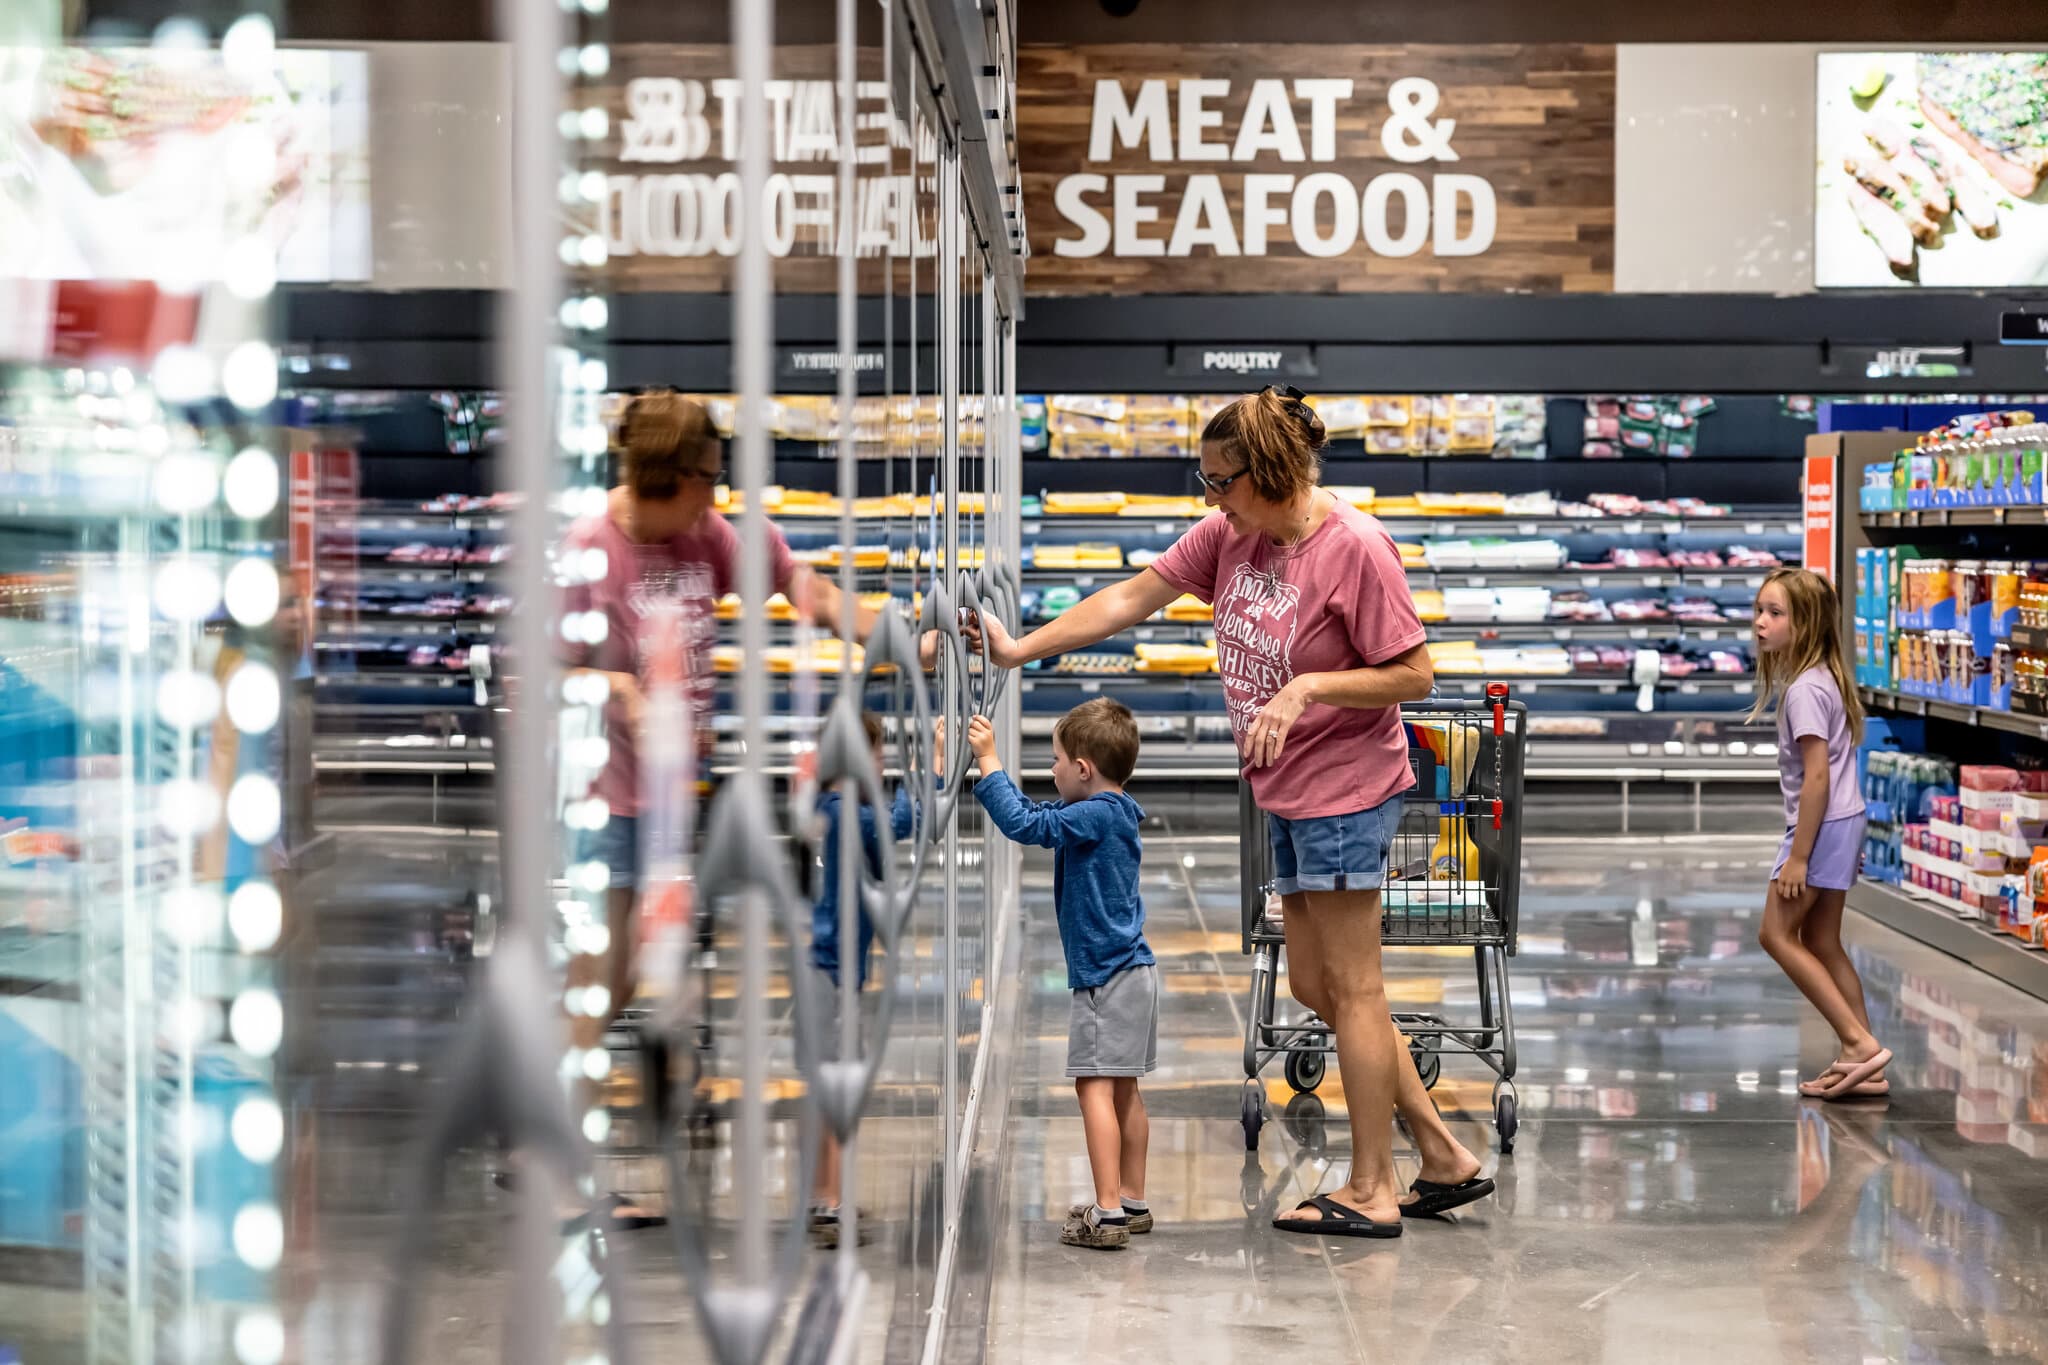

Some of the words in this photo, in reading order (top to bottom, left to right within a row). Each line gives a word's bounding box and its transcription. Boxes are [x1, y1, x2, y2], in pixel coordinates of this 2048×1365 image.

[1089, 78, 1354, 162] MEAT
[1381, 77, 1460, 163] &
[1054, 172, 1497, 258] SEAFOOD
[1203, 352, 1282, 370] POULTRY
[1224, 675, 1257, 695] WEET
